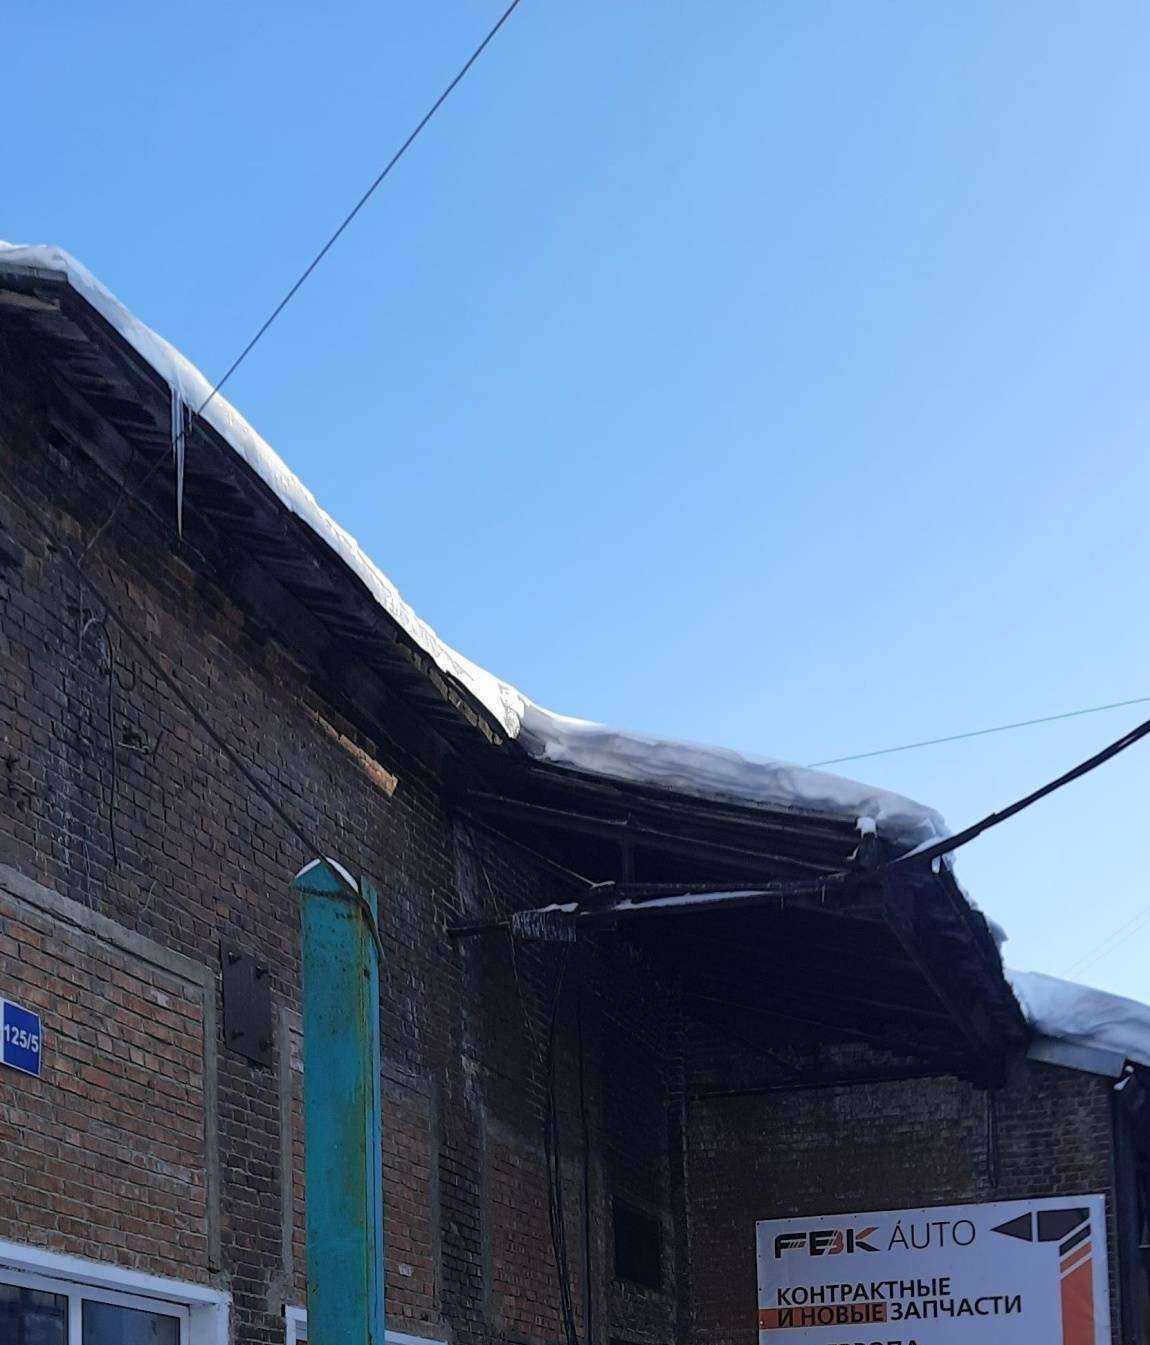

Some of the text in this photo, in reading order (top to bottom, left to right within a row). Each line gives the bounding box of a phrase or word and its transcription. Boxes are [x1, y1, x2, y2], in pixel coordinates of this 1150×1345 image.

[4, 1024, 39, 1053] 125/5
[777, 1277, 951, 1306] КОНТРАКТНЫЕ
[777, 1294, 1022, 1327] И НОВЫЕ ЗАПЧАСТИ
